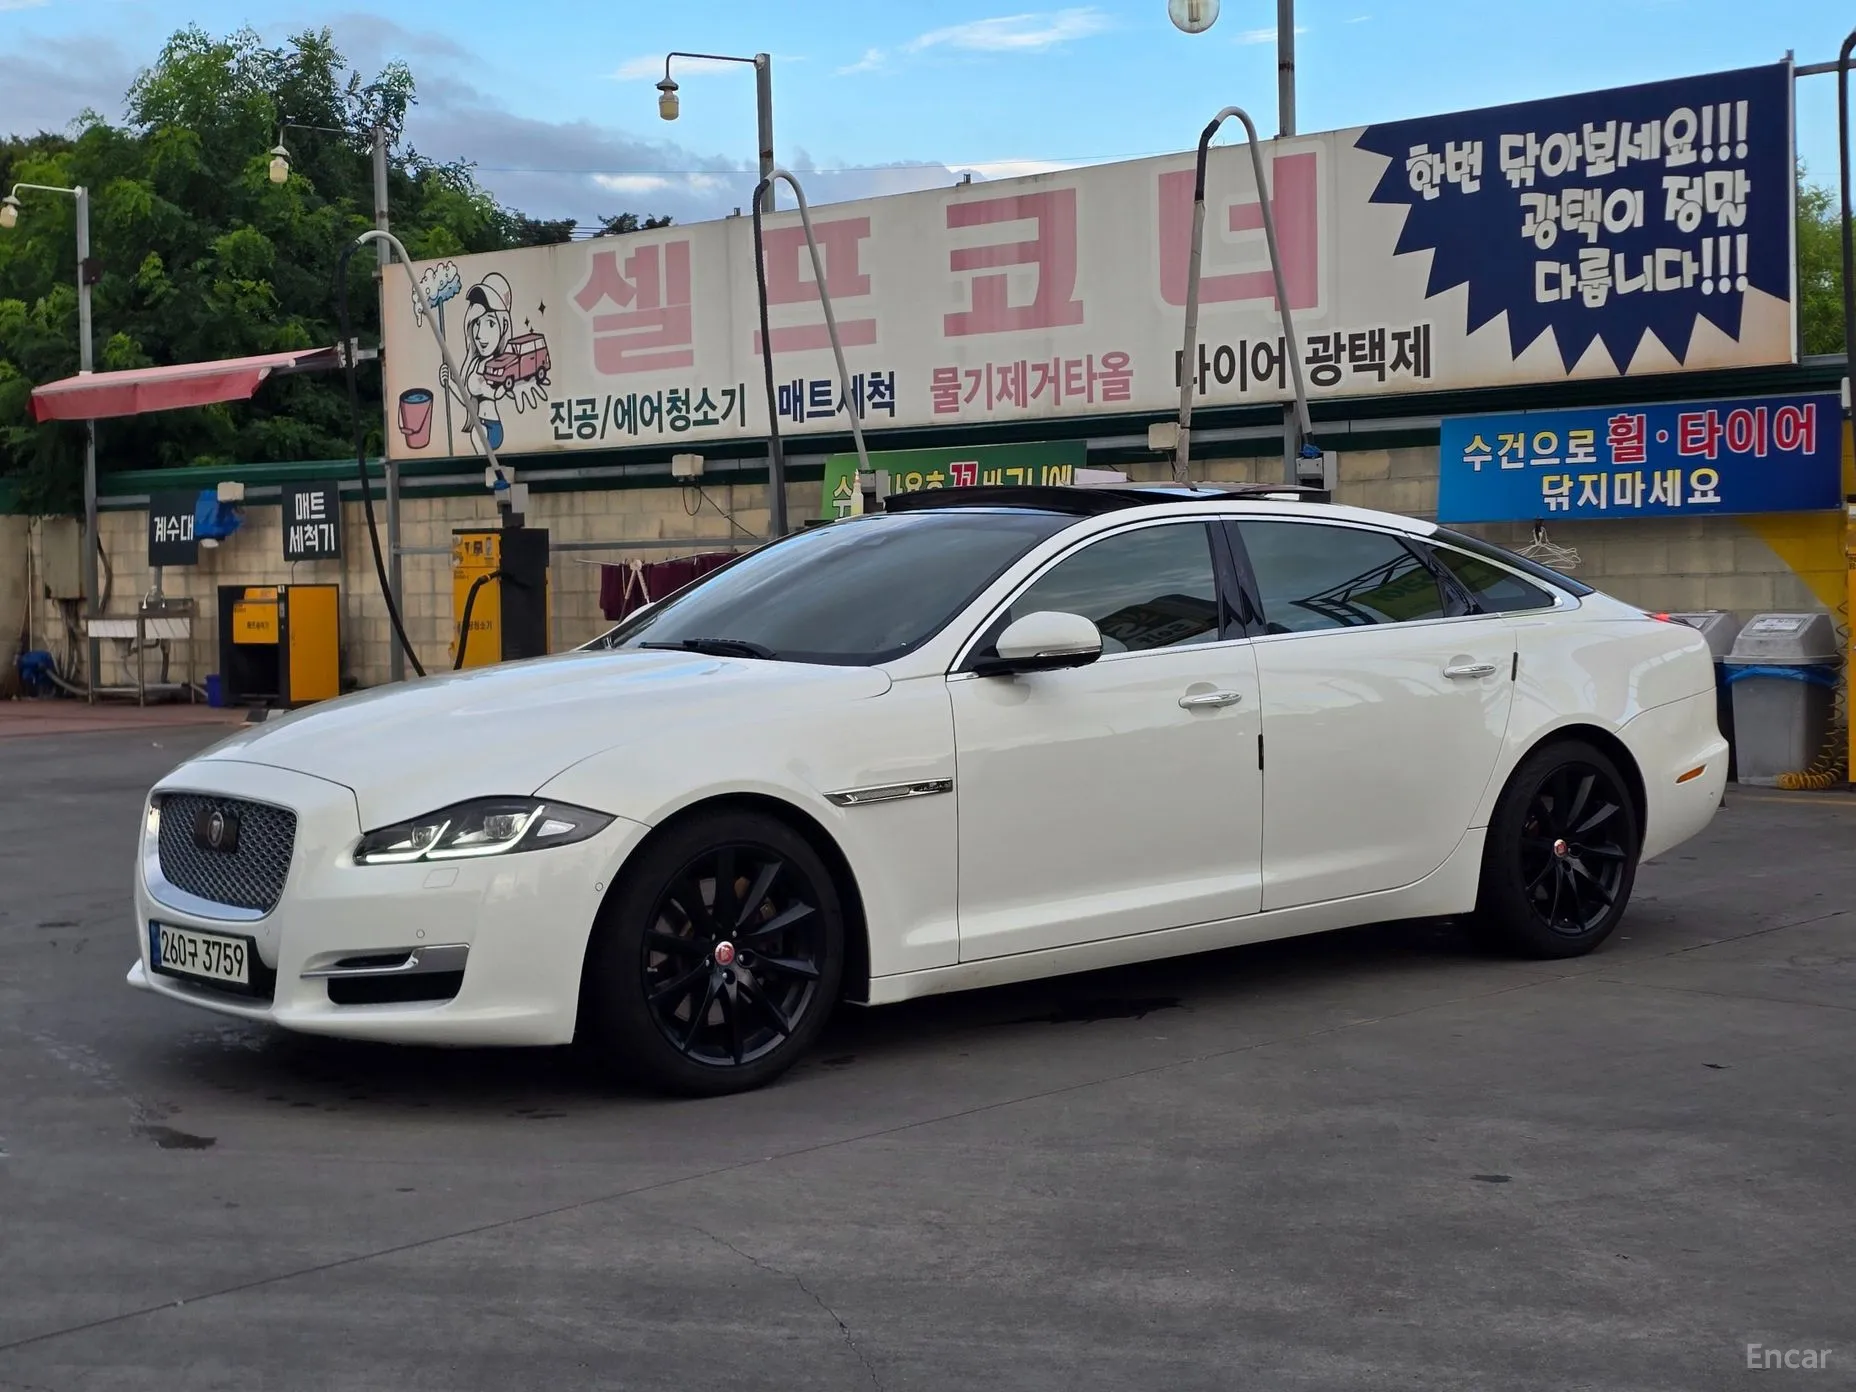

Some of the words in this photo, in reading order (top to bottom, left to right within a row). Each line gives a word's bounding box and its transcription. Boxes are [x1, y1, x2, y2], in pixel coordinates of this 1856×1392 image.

[1406, 140, 1483, 201] 한번
[1499, 100, 1749, 189] 닦아보세요!!!
[1519, 187, 1644, 250] 광택이
[1662, 169, 1752, 233] 정말
[1305, 323, 1431, 387] 광택제
[778, 371, 896, 424] 매트세척
[930, 351, 1134, 414] 물기제거타올
[550, 383, 746, 441] 진공/에어청소기
[1462, 430, 1598, 472] 수건으로
[294, 491, 326, 521] 매트
[1541, 468, 1722, 512] 닦지마세요
[154, 514, 195, 543] 계수대
[289, 523, 336, 553] 세척기
[161, 930, 198, 968] 260구
[202, 938, 244, 978] 3759
